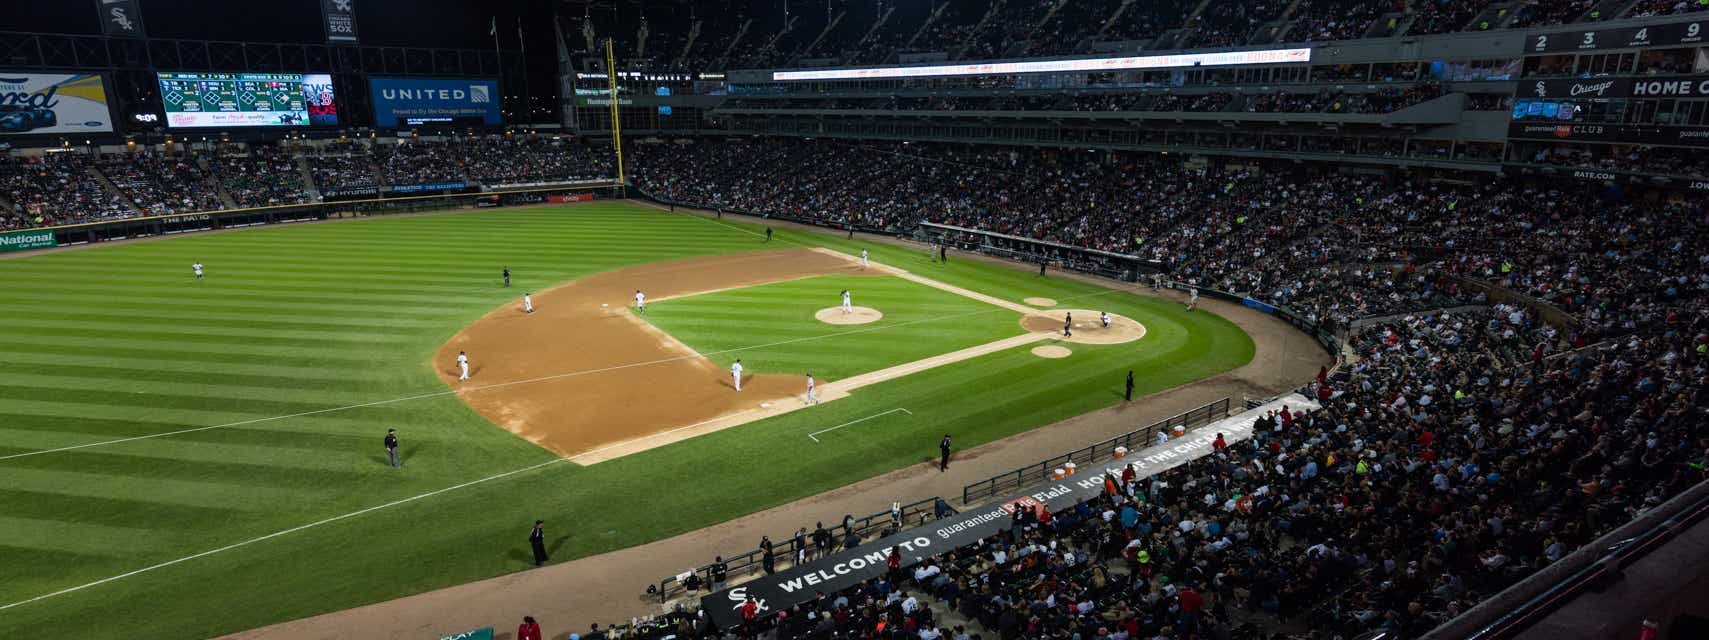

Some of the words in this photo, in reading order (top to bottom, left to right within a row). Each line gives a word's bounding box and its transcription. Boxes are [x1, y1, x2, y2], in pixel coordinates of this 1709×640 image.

[1635, 28, 1648, 40] 4
[1688, 23, 1700, 37] 9
[1536, 36, 1547, 47] 2
[1584, 32, 1595, 44] 3
[0, 78, 58, 108] ord
[382, 88, 465, 100] UNITED
[1570, 81, 1613, 97] Chicago
[1633, 81, 1692, 95] HOME
[136, 114, 157, 122] 9:09
[1574, 171, 1615, 180] RATE.COM
[0, 232, 53, 246] National
[1144, 450, 1177, 464] THE
[937, 506, 1009, 539] guaranteed
[1004, 498, 1036, 513] Rte
[1031, 484, 1072, 504] Field
[778, 546, 893, 593] WELCOME
[899, 537, 931, 551] TO
